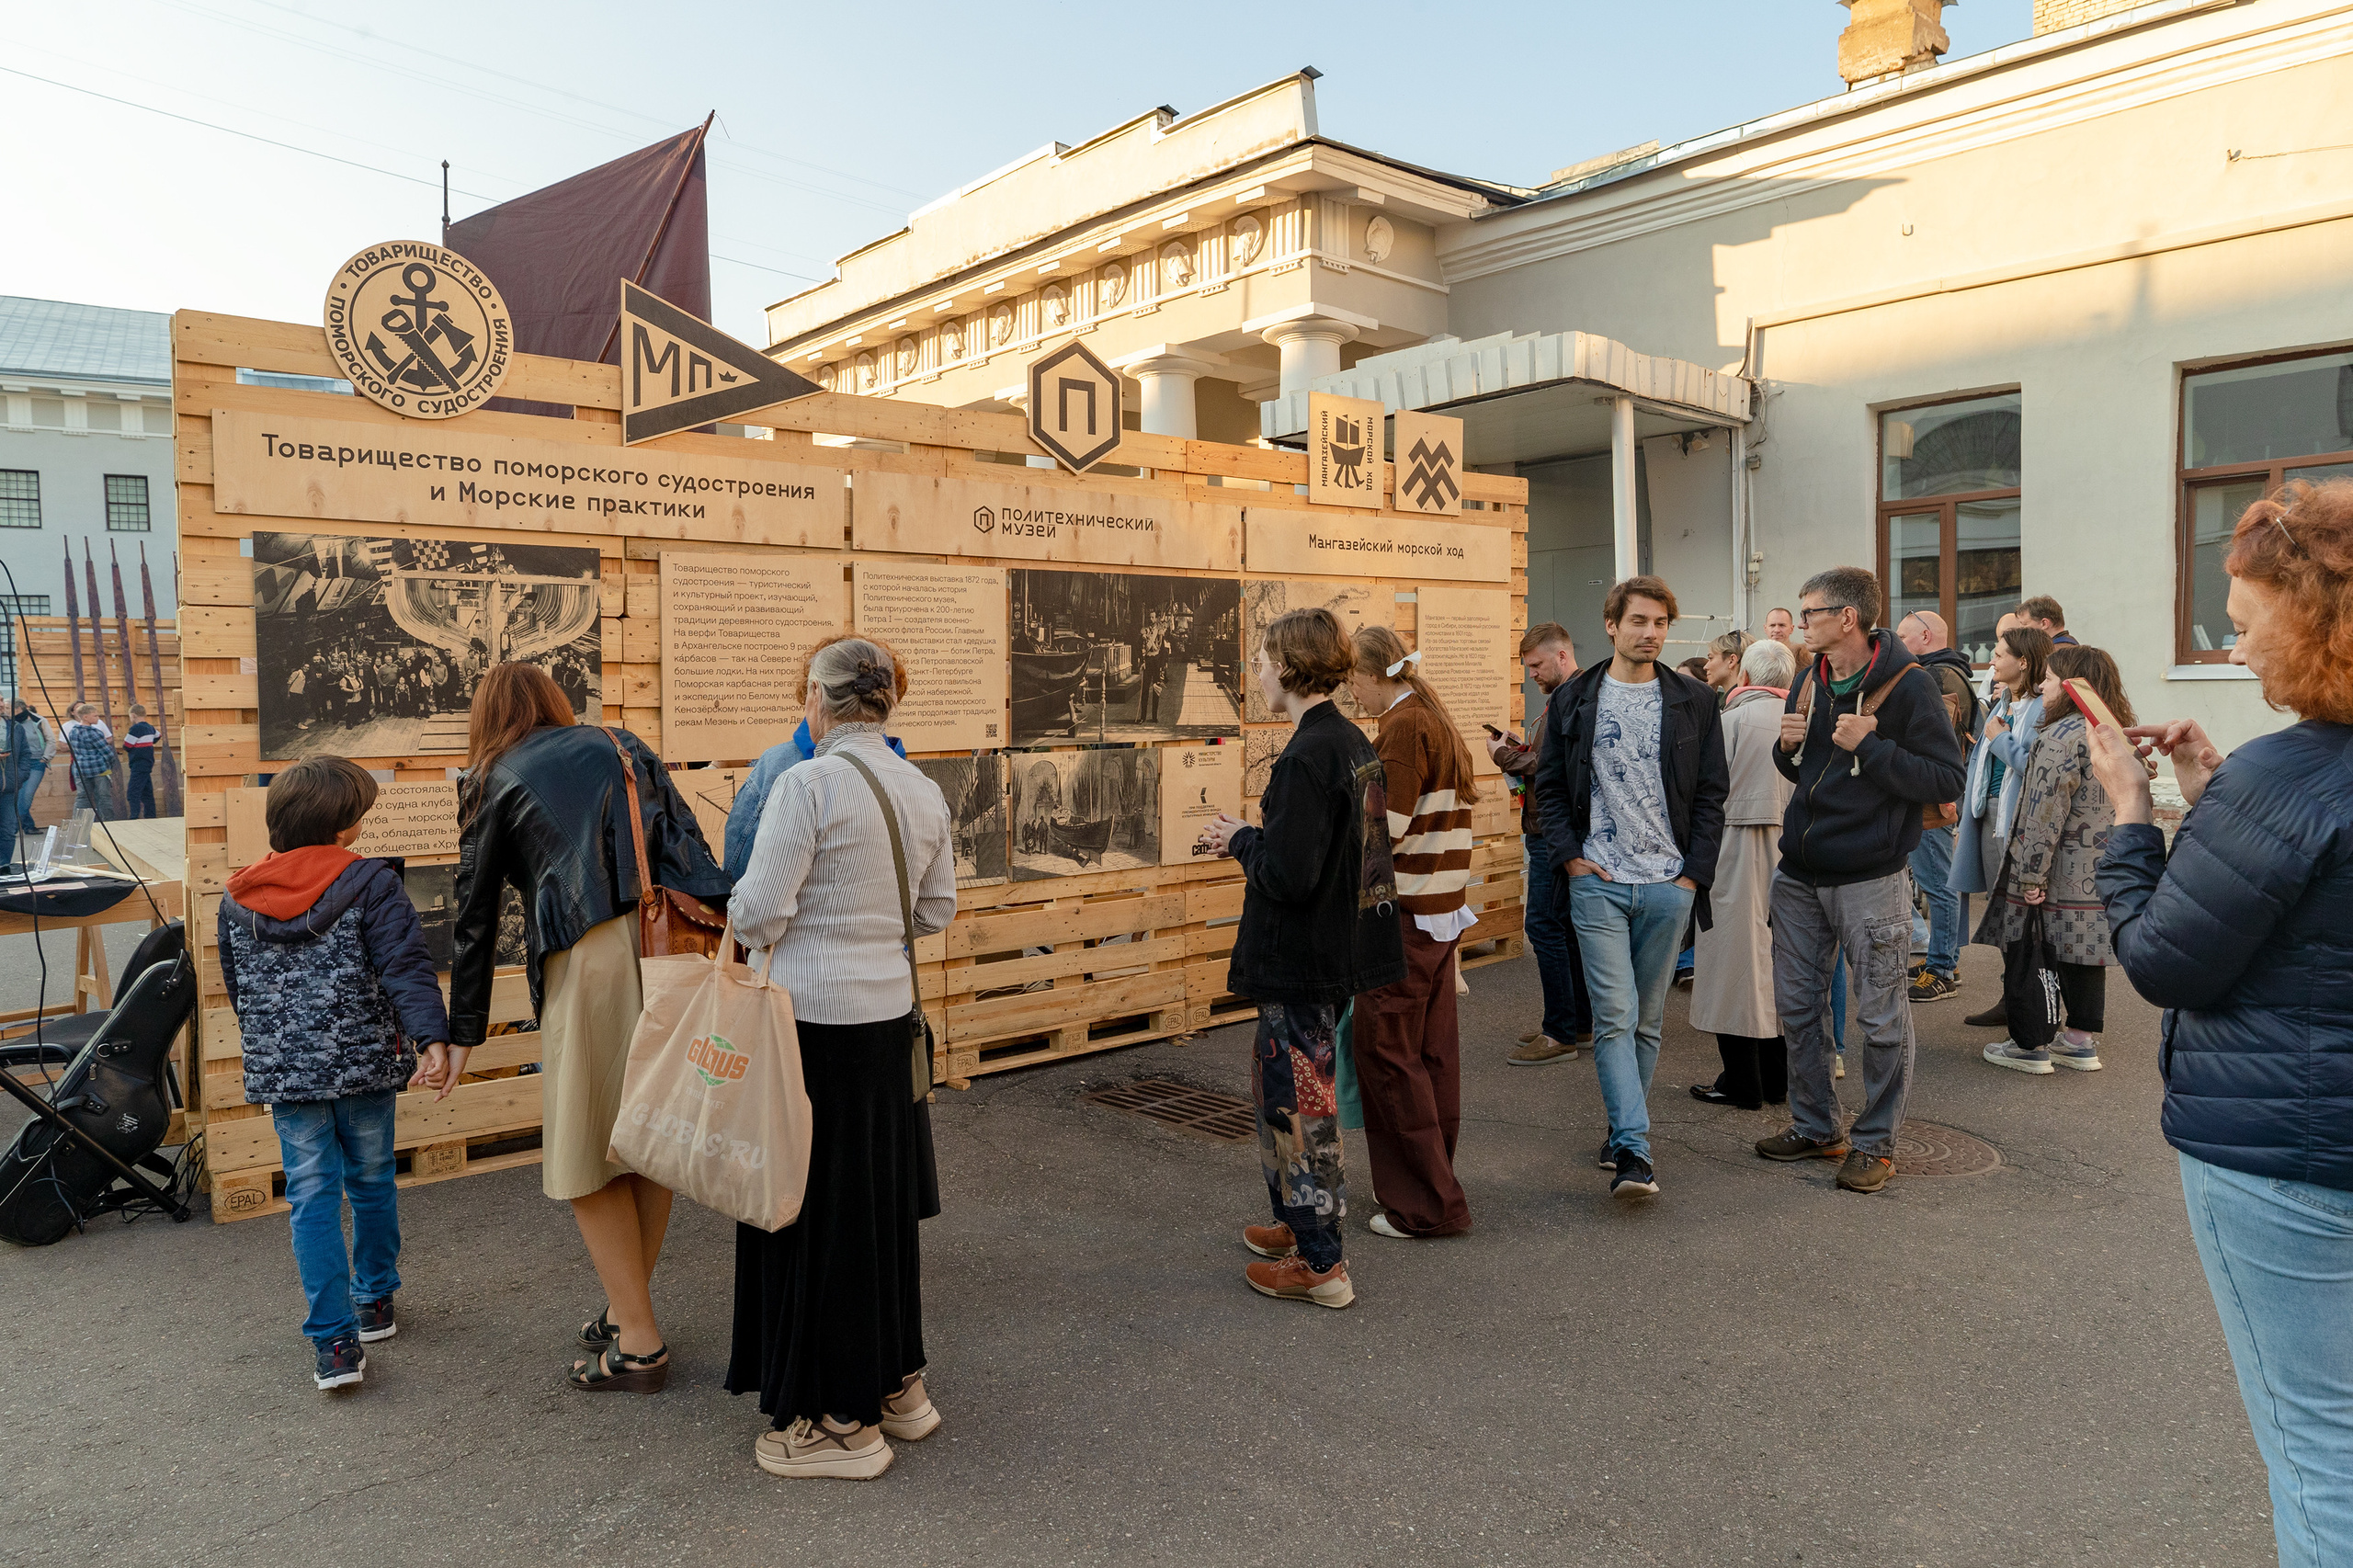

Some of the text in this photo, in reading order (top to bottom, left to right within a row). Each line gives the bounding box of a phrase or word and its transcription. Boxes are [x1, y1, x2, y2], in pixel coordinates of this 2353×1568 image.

[345, 244, 492, 300] ТОВАРИЩЕСТВО
[329, 295, 508, 415] ПОМОРСКОГО СУДОСТРОЕНИЯ
[261, 433, 814, 500] Товарищество поморского судостроения
[430, 481, 705, 522] и Морские практики
[1310, 534, 1463, 559] Мангазейский морской ход
[673, 563, 790, 578] Товарищество поморского
[863, 572, 928, 582] Политехническая
[673, 578, 811, 589] судостроения туристический
[870, 584, 900, 592] которой
[681, 591, 732, 600] культурный
[863, 594, 932, 602] Политехнического
[674, 604, 735, 613] сохраняющий
[745, 606, 803, 614] развивающий
[863, 604, 883, 612] была
[936, 606, 974, 614] 200-летию
[674, 616, 716, 625] традиции
[864, 615, 887, 624] Петра
[688, 629, 716, 638] верфи
[718, 629, 780, 639] Товарищества
[901, 626, 924, 634] флота
[681, 641, 743, 651] Архангельске
[744, 643, 789, 653] построено
[790, 642, 796, 651] 9
[914, 647, 938, 656] флота»
[972, 647, 995, 656] Петра,
[760, 654, 791, 664] Севере
[921, 657, 983, 666] Петропавловской
[674, 666, 714, 676] большие
[716, 668, 744, 676] лодки.
[907, 667, 972, 676] Санкт-Петербурге
[675, 680, 724, 689] Поморская
[726, 679, 772, 689] карбасная
[682, 694, 734, 703] экспедиции
[748, 691, 779, 701] Белому
[926, 687, 972, 697] набережной.
[675, 702, 806, 714] Кенозёрскому национальному
[962, 708, 997, 716] традицию
[675, 720, 702, 728] рекам
[747, 717, 788, 725] Северная
[934, 720, 957, 728] музея.
[390, 786, 454, 795] состоялась
[385, 801, 418, 811] судна
[421, 798, 453, 809] клуба
[408, 812, 455, 824] морской
[381, 828, 447, 838] обладатель
[374, 843, 430, 853] общества
[230, 1193, 258, 1210] EPAL
